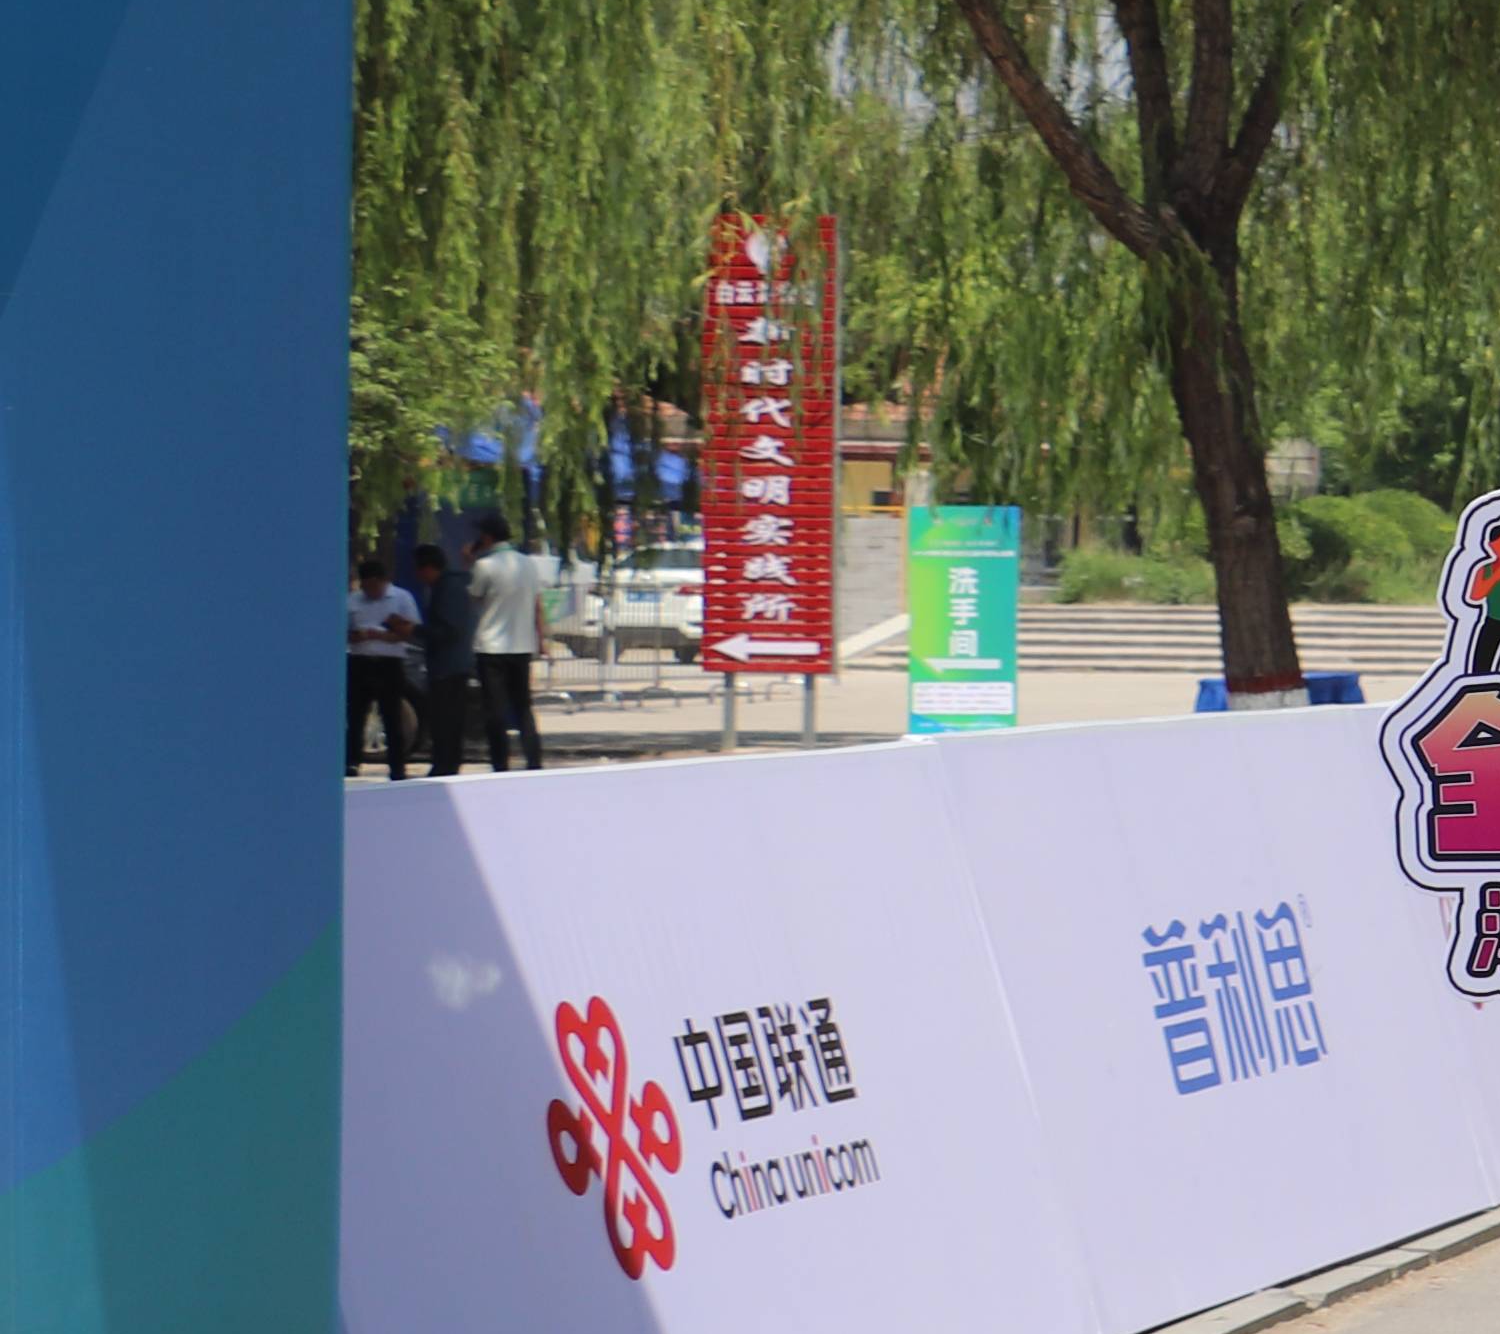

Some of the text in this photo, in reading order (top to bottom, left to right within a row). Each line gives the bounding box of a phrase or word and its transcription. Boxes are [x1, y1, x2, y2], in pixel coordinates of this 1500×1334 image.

[947, 566, 980, 657] 洗手间
[1141, 900, 1328, 1095] 普利思
[672, 997, 857, 1131] 中国联通
[785, 1133, 881, 1199] unicom
